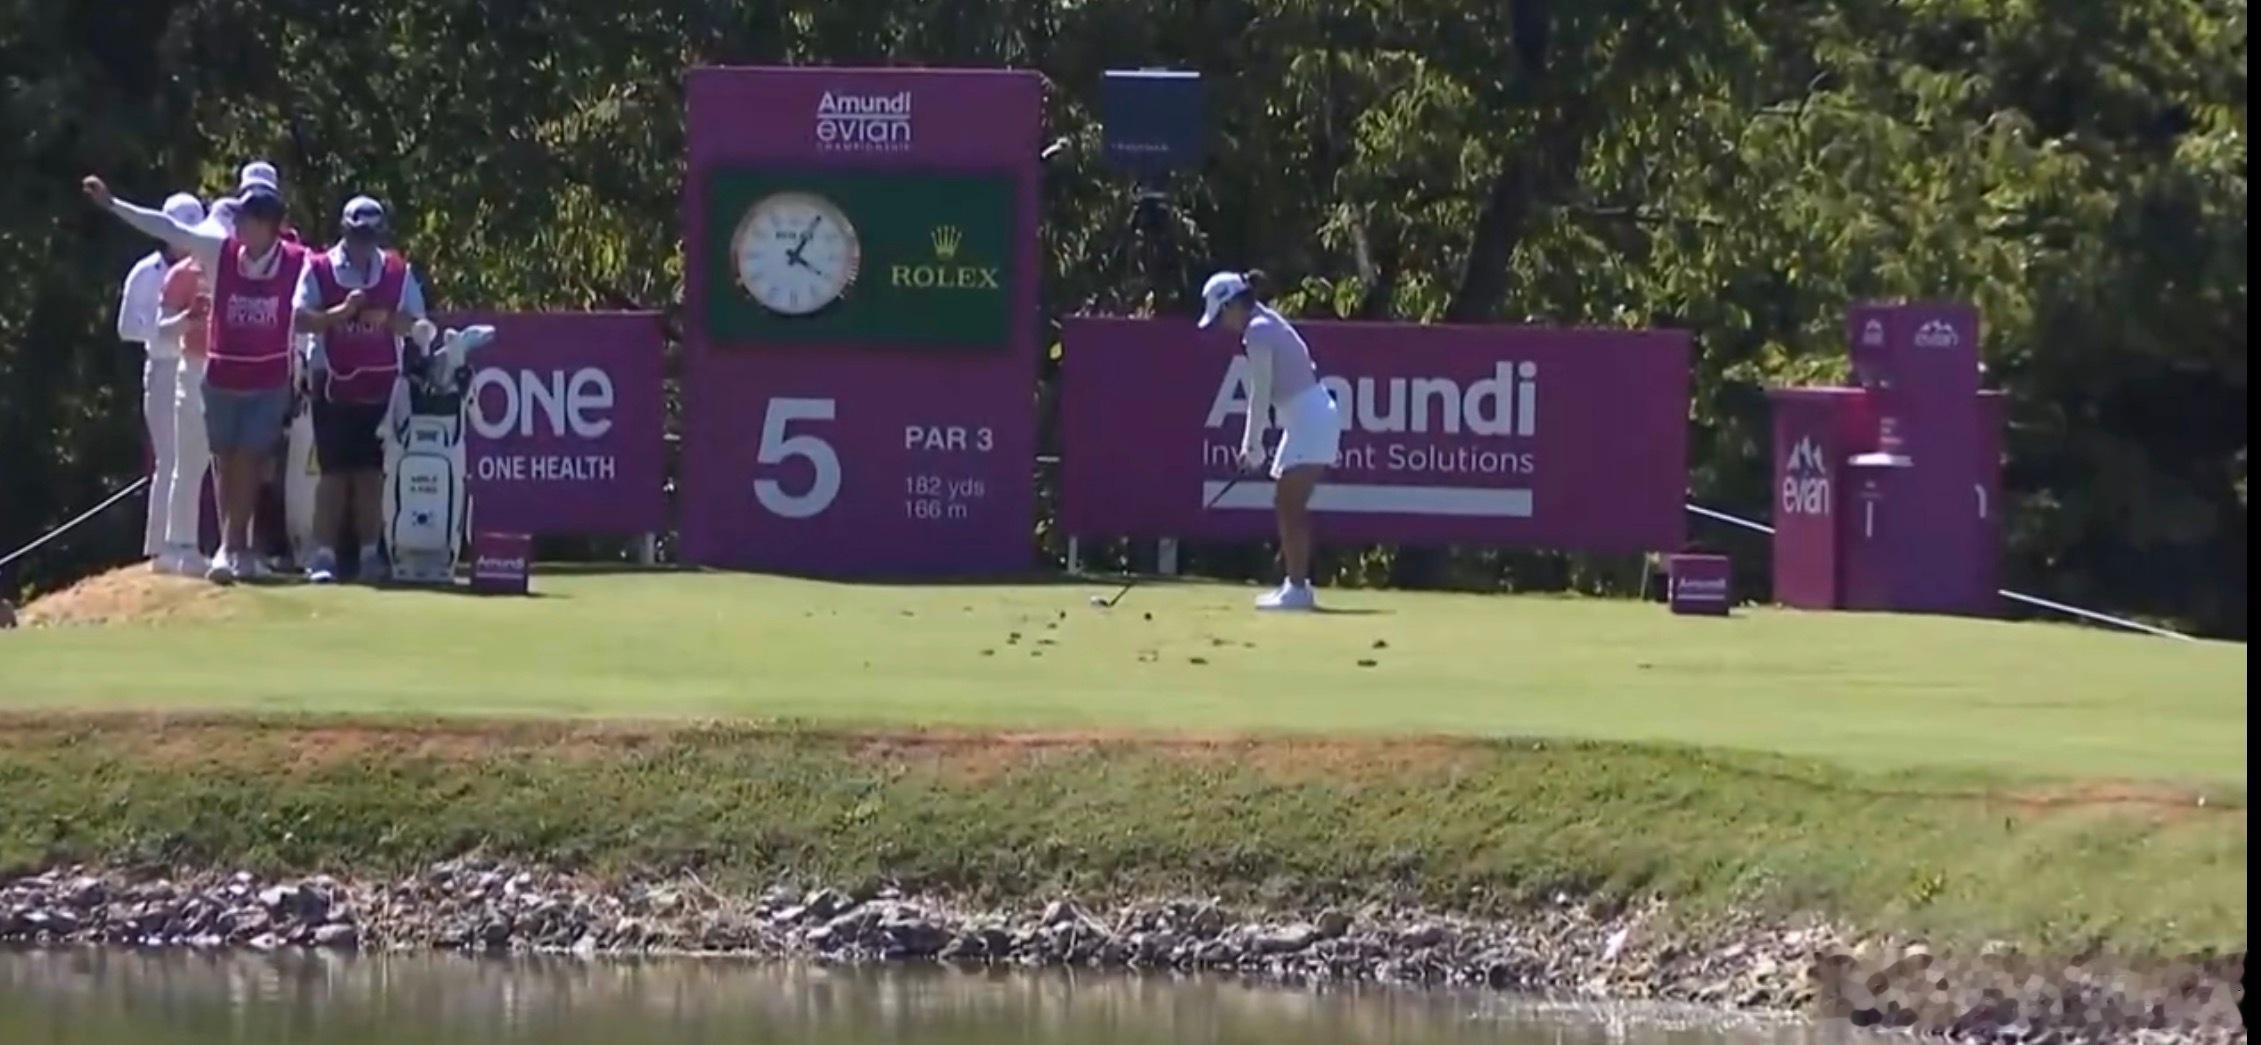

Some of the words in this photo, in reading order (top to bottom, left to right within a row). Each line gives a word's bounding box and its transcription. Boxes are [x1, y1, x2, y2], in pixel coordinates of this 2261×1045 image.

[818, 91, 911, 112] Amundi
[816, 120, 910, 141] evian
[892, 266, 999, 288] ROLEX
[905, 427, 967, 450] PAR
[976, 427, 993, 451] 3
[478, 456, 526, 480] ONE
[531, 456, 615, 480] HEALTH
[753, 397, 842, 518] 5
[1388, 442, 1534, 474] Solutions
[905, 477, 941, 495] 182
[949, 477, 985, 499] yds
[1783, 476, 1830, 514] evian
[905, 501, 941, 519] 166
[949, 504, 967, 518] m
